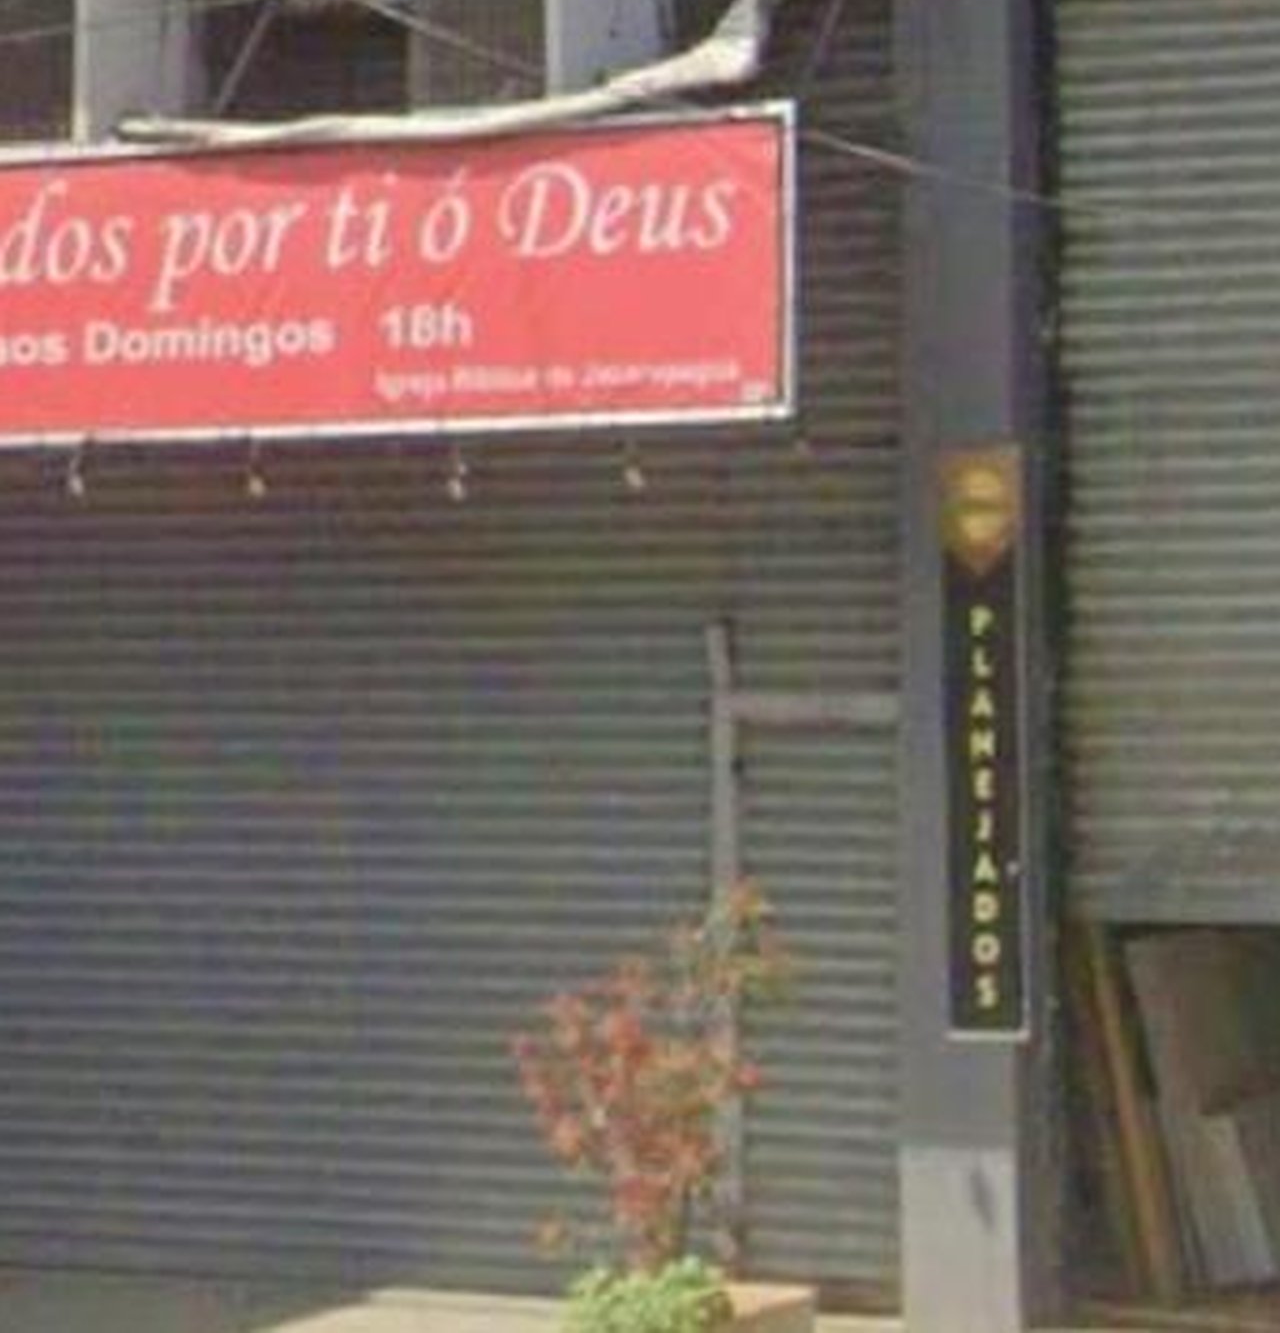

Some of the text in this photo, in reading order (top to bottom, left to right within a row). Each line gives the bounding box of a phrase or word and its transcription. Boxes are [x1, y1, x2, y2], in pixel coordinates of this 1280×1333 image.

[150, 201, 304, 312] por
[326, 170, 393, 268] ti
[421, 165, 471, 263] ó
[498, 162, 737, 256] Deus
[84, 319, 335, 368] Domingos
[379, 304, 473, 350] 18h
